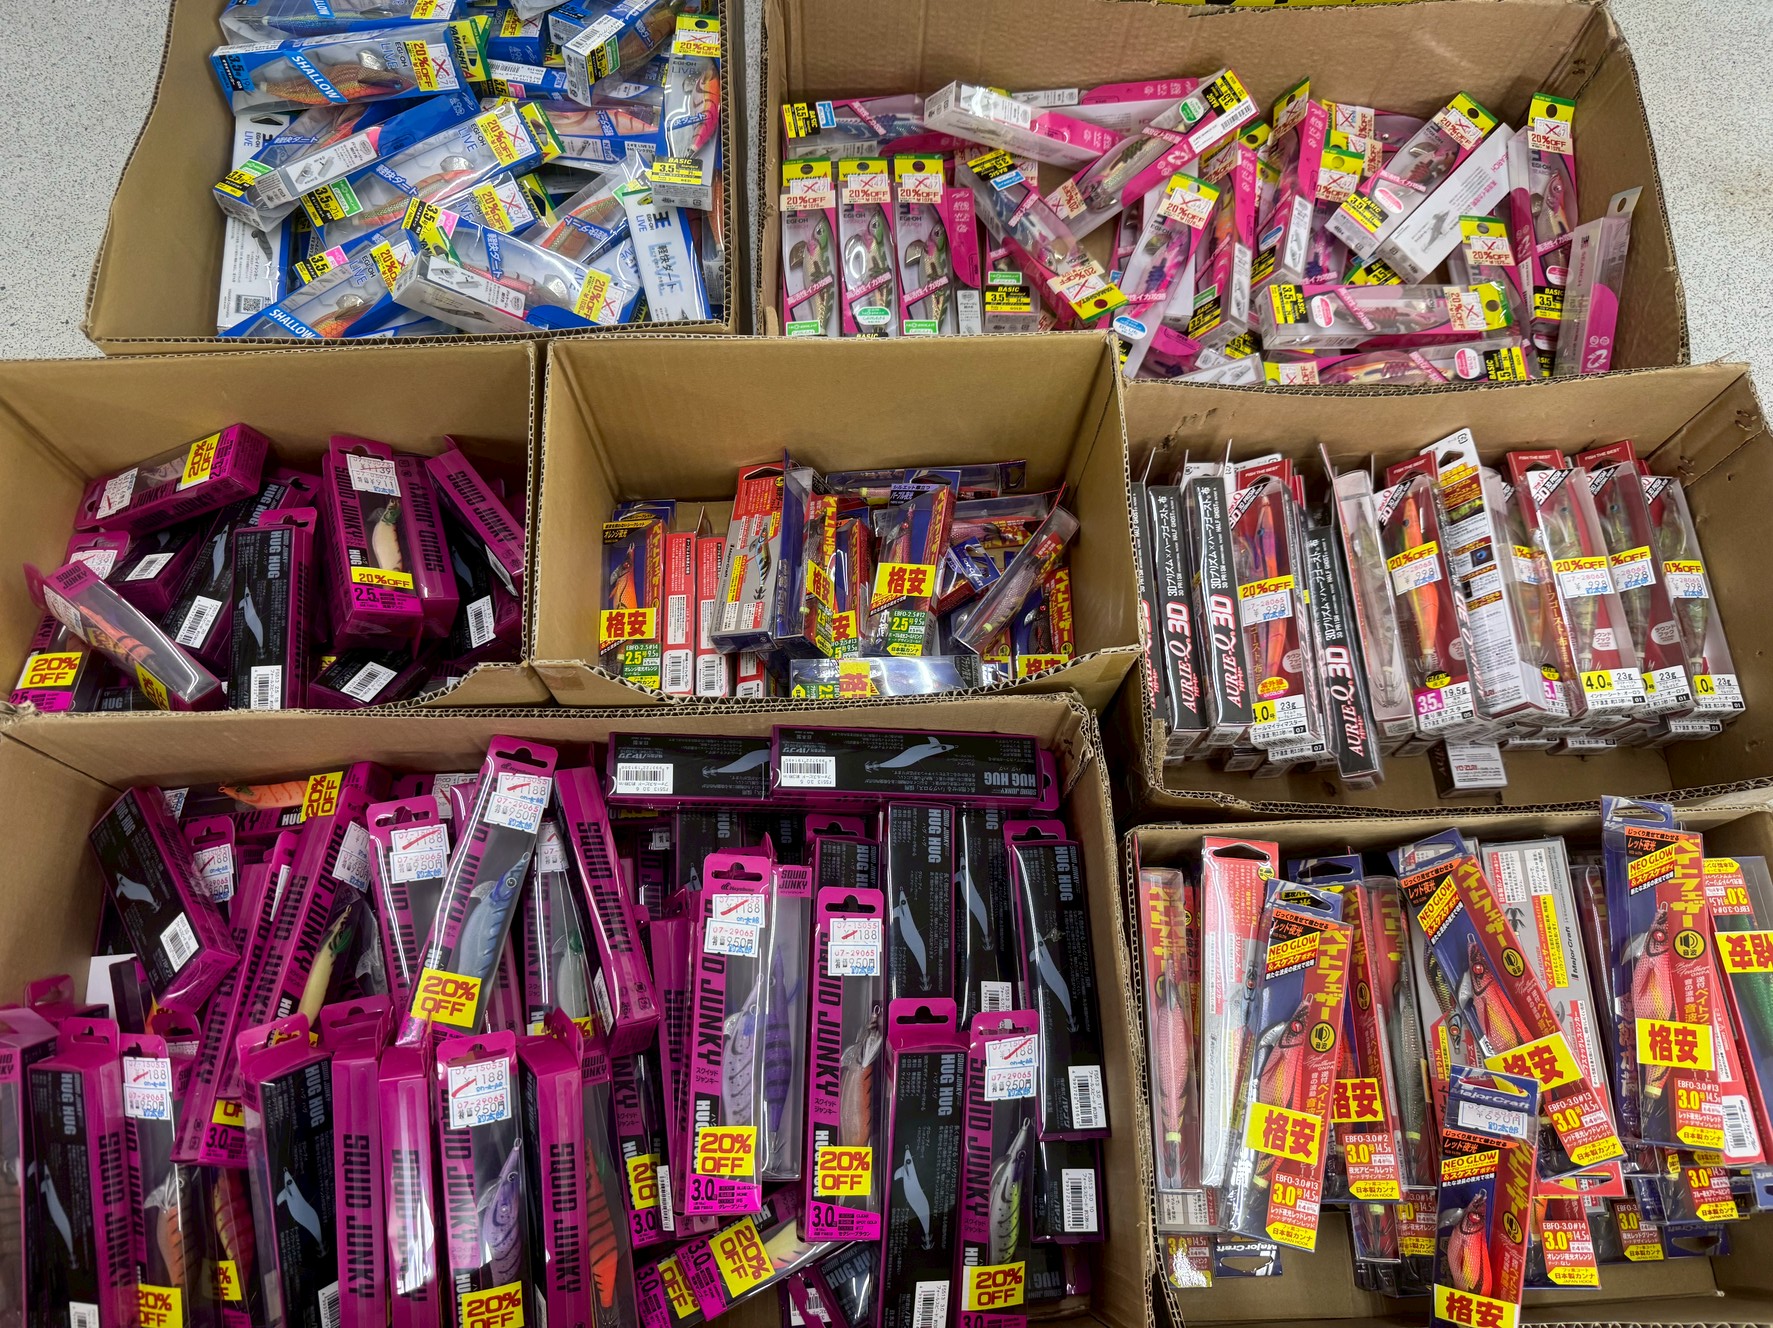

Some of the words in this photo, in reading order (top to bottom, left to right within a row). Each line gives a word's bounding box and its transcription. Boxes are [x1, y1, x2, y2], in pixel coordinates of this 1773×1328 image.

[381, 43, 398, 69] LIVE
[450, 25, 477, 81] YAMASHITA
[413, 42, 433, 88] 20%OFF
[291, 55, 340, 100] SHALLOW
[244, 130, 253, 147] LIVE
[458, 126, 478, 152] LIVE
[471, 123, 486, 147] EGI-OH
[486, 117, 515, 162] 20%OFF
[1424, 126, 1444, 143] EGI-OH
[1441, 117, 1478, 146] 20%OFF
[1531, 133, 1567, 147] 20%OFF
[1531, 161, 1552, 169] EGI-OH
[786, 196, 826, 205] 20%OFF
[848, 189, 888, 198] 20%OFF
[900, 189, 940, 197] 20%OFF
[1362, 194, 1382, 212] BASIC
[483, 191, 507, 232] 20%OFF
[1166, 202, 1205, 223] 20%OFF
[635, 215, 648, 232] LIVE
[361, 255, 376, 277] EGI-OH
[486, 232, 504, 278] 軽快ダート
[1472, 251, 1511, 262] 20%OFF
[351, 260, 367, 284] LIVE
[585, 278, 605, 320] 20%OFF
[1077, 286, 1115, 308] YAMASHITA
[1197, 303, 1215, 314] BASIC
[1296, 293, 1306, 315] BASIC
[1450, 292, 1466, 329] 20%OFF
[269, 309, 319, 338] SHALLOW
[1486, 359, 1496, 381] BASIC
[188, 440, 208, 479] 20%
[200, 442, 215, 473] OFF
[408, 482, 440, 528] JUNKY
[473, 507, 518, 544] JUNKY
[273, 530, 282, 553] HUG
[419, 531, 446, 573] SQUID
[268, 555, 280, 579] HUG
[349, 549, 362, 566] HUG
[1389, 546, 1435, 571] 20%OFF
[1556, 559, 1606, 572] 20%OFF
[56, 564, 81, 582] SQUID
[62, 570, 88, 590] JUNKY
[359, 572, 410, 588] 20%OFF
[888, 566, 928, 596] 格安
[1242, 581, 1292, 598] 20%OFF
[606, 611, 647, 638] 格安
[31, 657, 78, 672] 20%
[1617, 672, 1632, 680] 23g
[1659, 672, 1676, 680] 23g
[29, 672, 69, 685] OFF
[1717, 678, 1731, 686] 23g
[1444, 687, 1466, 697] 19.5g
[1280, 701, 1296, 710] 23g
[984, 772, 1009, 786] HUG
[1012, 772, 1036, 786] HUG
[305, 775, 327, 818] 20%
[320, 779, 338, 814] OFF
[928, 808, 942, 833] HUG
[576, 821, 614, 880] SQUID
[928, 837, 941, 863] HUG
[1054, 846, 1068, 871] HUG
[1630, 859, 1648, 873] NEO
[1649, 847, 1673, 864] GLOW
[779, 880, 808, 890] JUNKY
[780, 870, 807, 879] SQUID
[1058, 875, 1073, 901] HUG
[592, 884, 634, 952] JUNKY
[1269, 945, 1289, 956] NEO
[1290, 934, 1318, 949] GLOW
[422, 976, 476, 1001] 20%
[421, 996, 466, 1016] OFF
[697, 977, 724, 1066] JUNKY
[1648, 1027, 1699, 1064] 格安
[941, 1054, 955, 1081] HUG
[1503, 1045, 1566, 1085] 格安
[60, 1073, 73, 1102] HUG
[305, 1064, 321, 1095] HUG
[1678, 1080, 1719, 1092] EBFO-3.0#13
[938, 1085, 953, 1116] HUG
[968, 1058, 993, 1132] SQUID
[1333, 1079, 1380, 1119] 格安
[1548, 1092, 1592, 1112] EBFO-3.0#13
[1678, 1089, 1706, 1110] 3.0号
[63, 1105, 77, 1136] HUG
[308, 1098, 325, 1128] HUG
[1553, 1106, 1583, 1132] 3.0号
[206, 1125, 228, 1149] 3.0
[1263, 1110, 1317, 1158] 格安
[1488, 1122, 1519, 1134] 釣太郎
[701, 1132, 752, 1154] 20%
[1347, 1144, 1375, 1163] 3.0号
[1375, 1143, 1391, 1152] 14.5g
[1444, 1139, 1478, 1153] レッド夜光
[1577, 1143, 1617, 1160] 日本製カンナ
[98, 1131, 128, 1206] SQUID
[701, 1157, 744, 1174] OFF
[820, 1151, 870, 1171] 20%
[1444, 1158, 1465, 1168] NEO
[1466, 1152, 1497, 1164] GLOW
[343, 1134, 372, 1210] SQUID
[551, 1142, 577, 1212] SQUID
[820, 1175, 863, 1191] OFF
[966, 1137, 991, 1217] JUNKY
[1276, 1174, 1318, 1190] EBFO-3.0#13
[691, 1178, 714, 1201] 3.0
[1273, 1183, 1302, 1206] 3.0号
[1303, 1189, 1318, 1201] 14.5g
[447, 1165, 477, 1243] JUNKY
[1702, 1208, 1735, 1216] 日本製カンナ
[811, 1206, 834, 1227] 3.0
[1542, 1222, 1586, 1230] EBFO-3.0#14
[1273, 1228, 1313, 1241] 日本製カンナ
[1544, 1231, 1573, 1250] 3.0号
[1573, 1231, 1589, 1240] 14.5g
[105, 1214, 132, 1287] JUNKY
[346, 1215, 375, 1299] JUNKY
[554, 1218, 581, 1293] JUNKY
[720, 1238, 747, 1279] OFF
[738, 1225, 768, 1280] 20%
[660, 1269, 687, 1308] OFF
[975, 1266, 1023, 1289] 20%
[135, 1292, 172, 1311] 20%
[467, 1290, 521, 1318] 20%
[977, 1288, 1016, 1306] OFF
[470, 1311, 514, 1328] OFF
[1447, 1295, 1504, 1327] 格安
